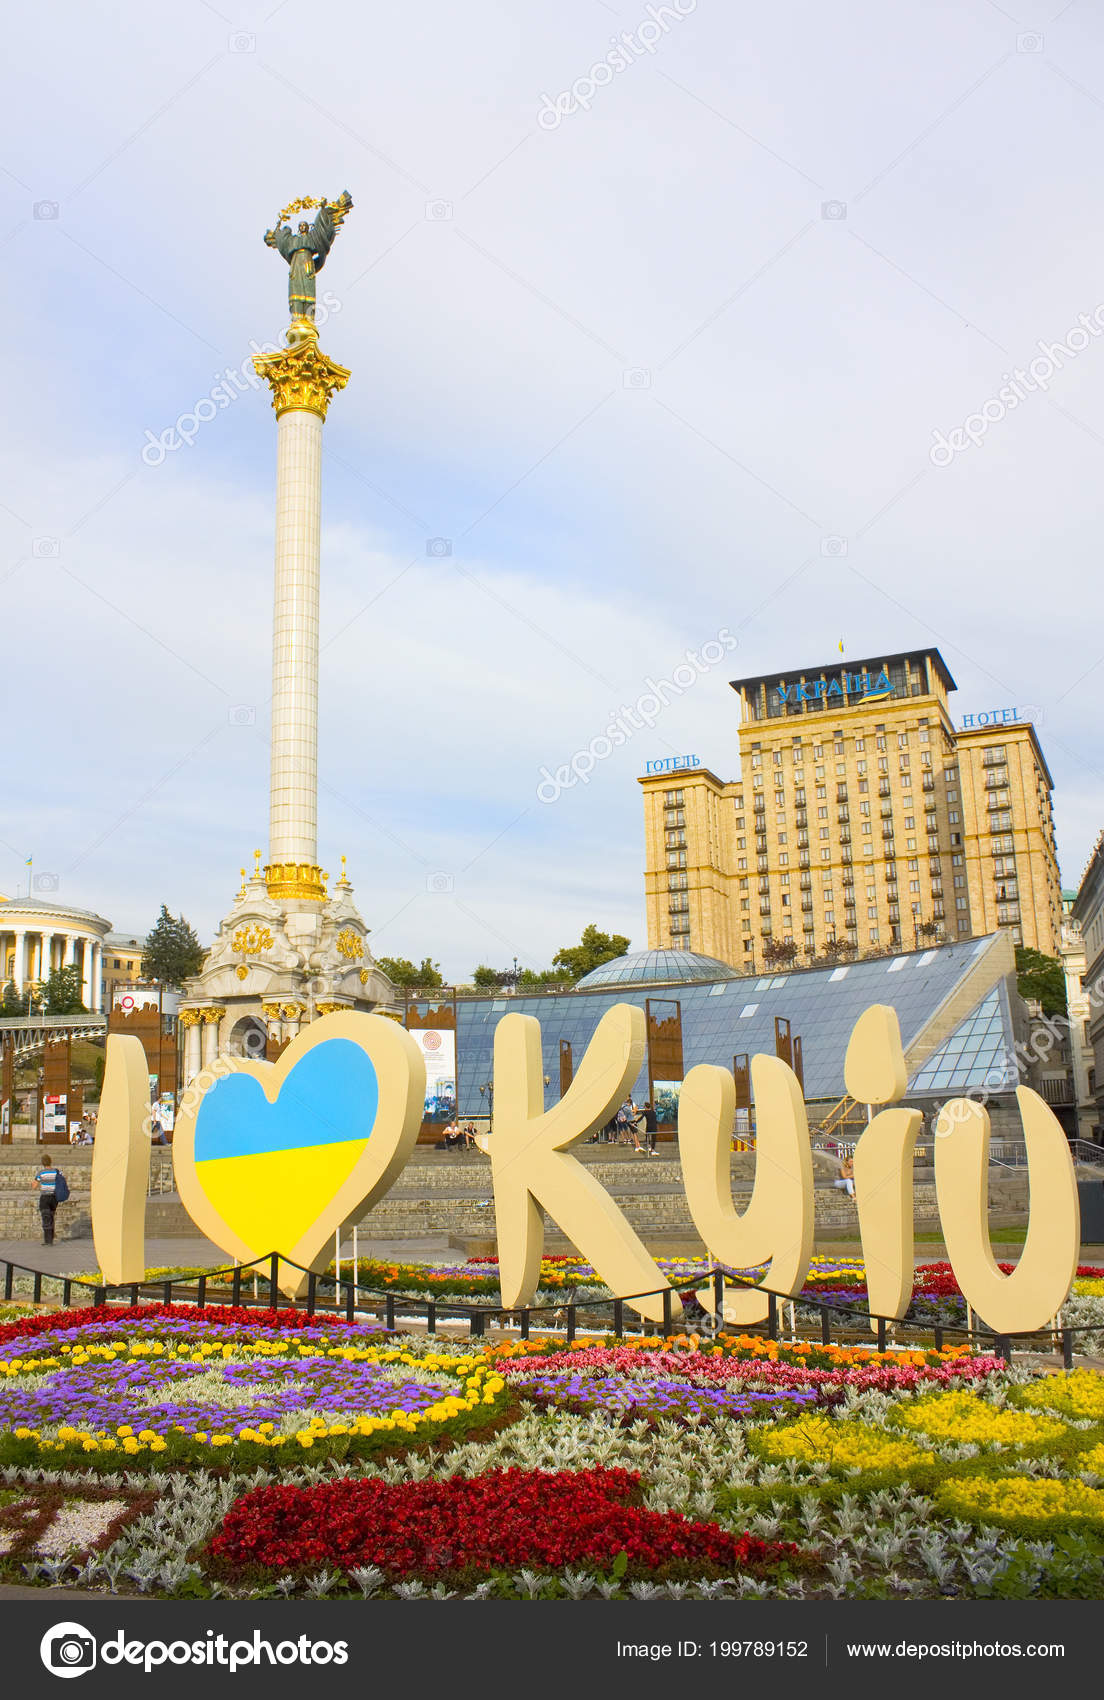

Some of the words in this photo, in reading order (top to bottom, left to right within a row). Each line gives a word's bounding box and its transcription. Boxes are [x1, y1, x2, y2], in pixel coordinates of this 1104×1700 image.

[776, 671, 893, 704] УКРАЇНА
[963, 707, 1021, 728] HOTEL
[646, 754, 700, 773] ГОТЕЛЬ
[91, 1033, 151, 1285] I
[475, 1002, 1080, 1334] Kyiv
